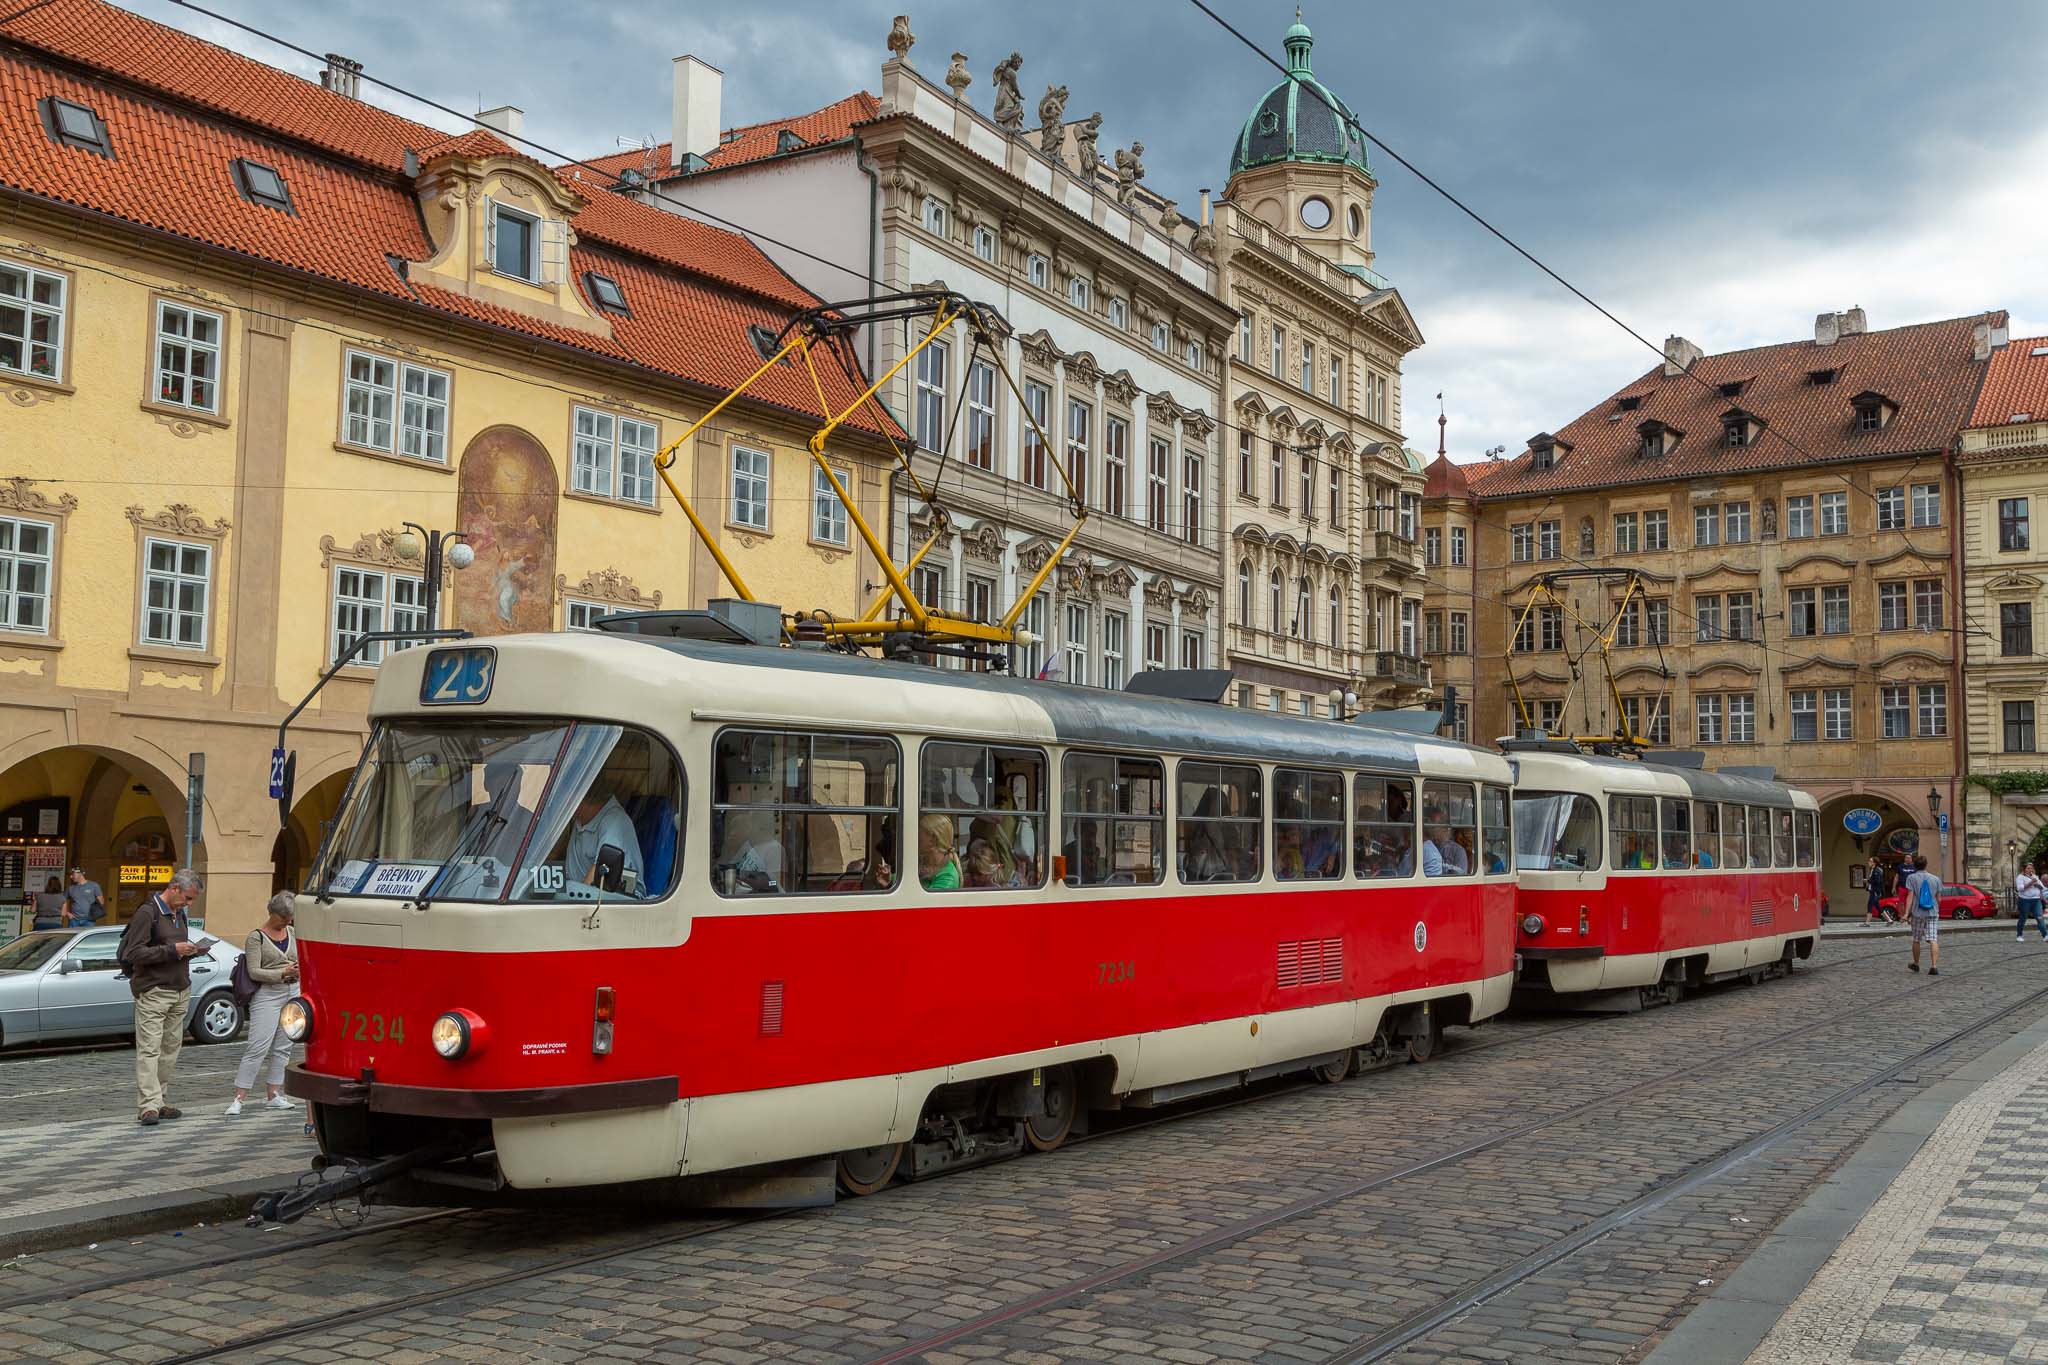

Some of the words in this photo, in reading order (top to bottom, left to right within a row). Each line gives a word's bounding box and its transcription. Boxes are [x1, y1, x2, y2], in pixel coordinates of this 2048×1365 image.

[432, 653, 493, 699] 23
[271, 757, 285, 786] 23
[1941, 815, 1947, 827] P
[377, 866, 428, 883] BŘEVNOV
[530, 865, 564, 889] 105
[1099, 960, 1135, 985] 7234
[340, 1010, 405, 1046] 7234
